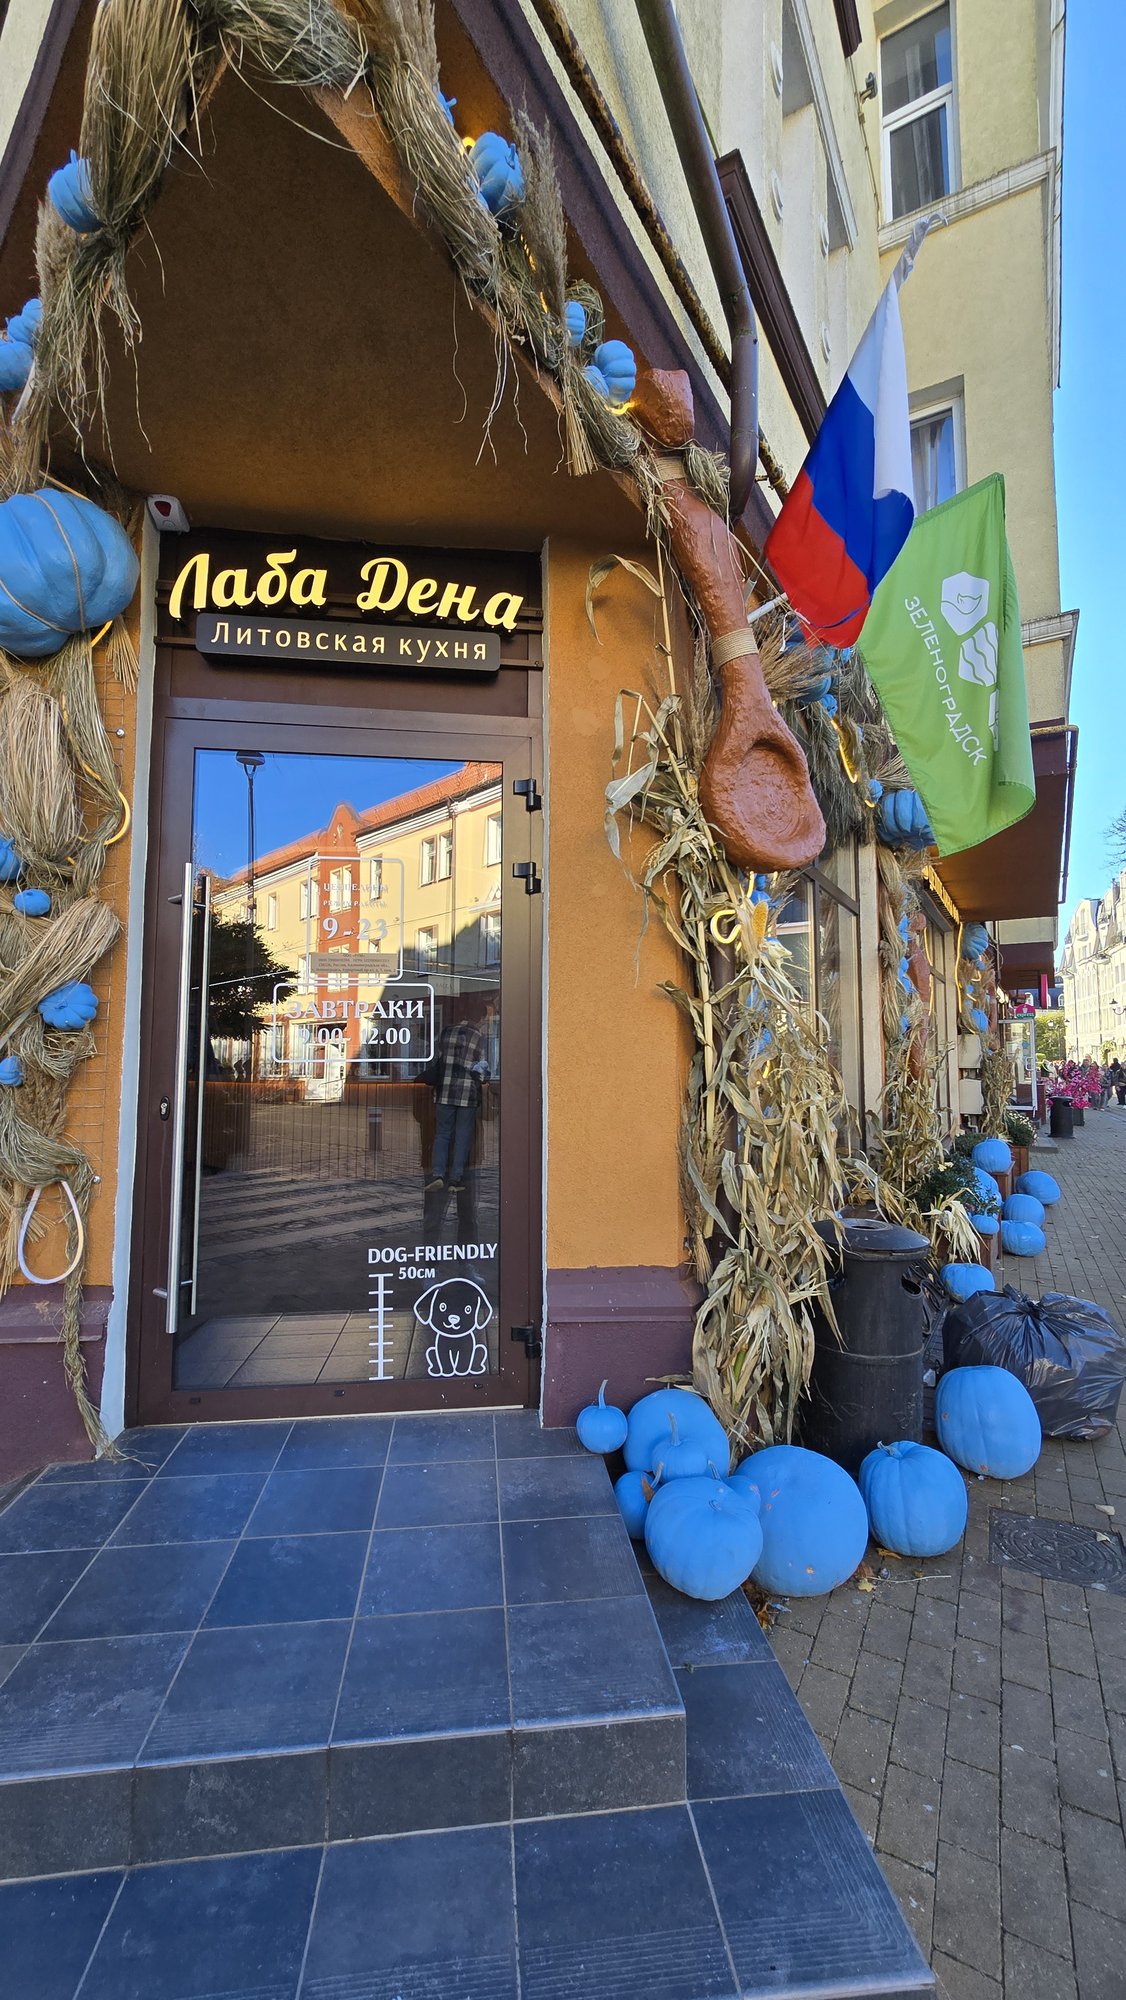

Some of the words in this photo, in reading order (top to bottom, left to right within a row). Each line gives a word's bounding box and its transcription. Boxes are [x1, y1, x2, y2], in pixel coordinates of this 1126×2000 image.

[168, 548, 328, 619] Лаба
[355, 557, 524, 630] Дена
[211, 621, 386, 654] Литовская
[399, 636, 487, 663] кухня
[904, 595, 988, 767] ЗЕЛЕНОГРАДСК
[322, 917, 339, 940] 9
[357, 918, 389, 941] 23
[285, 1000, 425, 1019] ЗАВТРАКИ
[360, 1027, 411, 1045] 12.00
[367, 1242, 498, 1264] DOG-FRIENDLY
